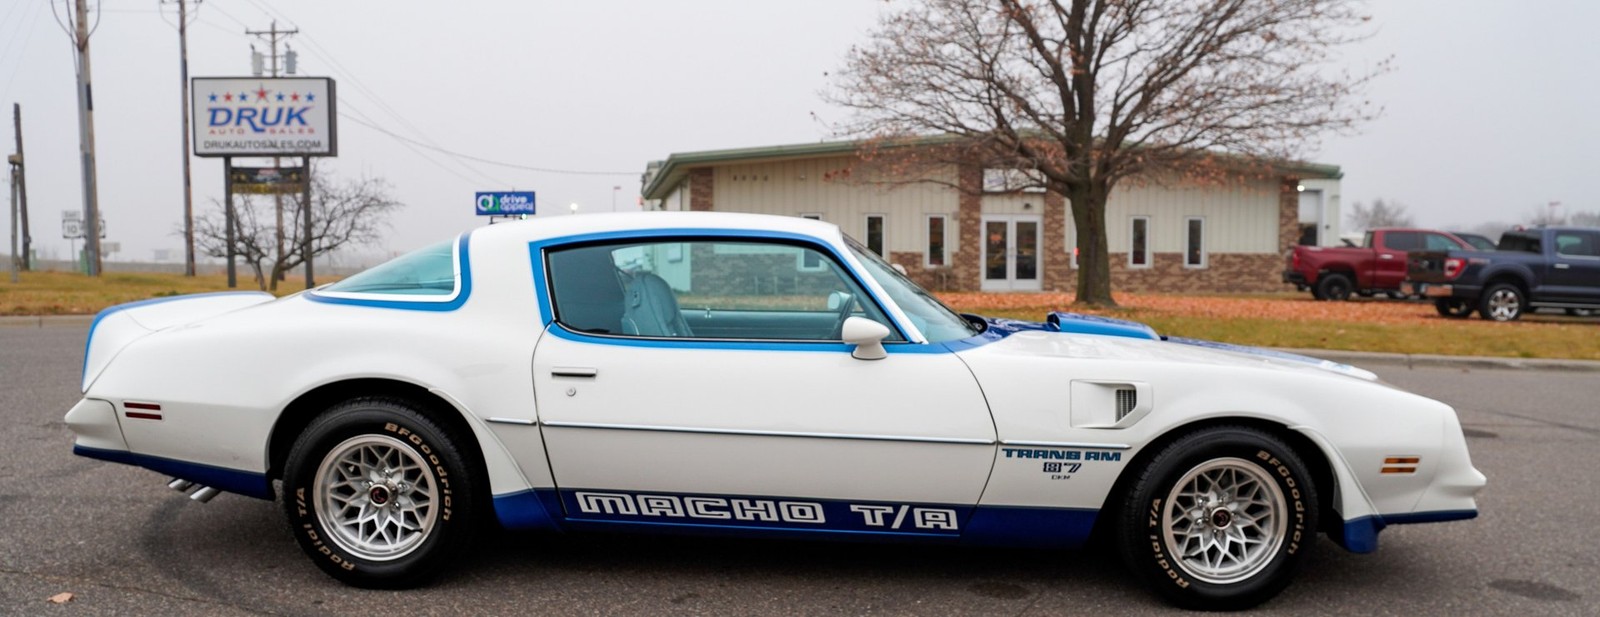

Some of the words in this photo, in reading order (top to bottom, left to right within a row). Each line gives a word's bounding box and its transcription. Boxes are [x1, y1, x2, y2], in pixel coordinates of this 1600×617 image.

[207, 106, 314, 133] DRUK
[203, 140, 321, 149] DRUKAUTOSALES.COM
[500, 194, 527, 203] drive
[1002, 448, 1081, 460] TRANS
[1084, 451, 1121, 461] AM
[1043, 462, 1081, 473] 87
[384, 422, 452, 520] BFGoodrich
[296, 487, 307, 517] T/A
[575, 491, 826, 524] MACHO
[850, 503, 958, 530] T/A
[1150, 498, 1161, 527] T/A
[1257, 450, 1305, 555] BFGoodrich
[304, 523, 356, 571] Radial
[1150, 534, 1190, 589] Radial
